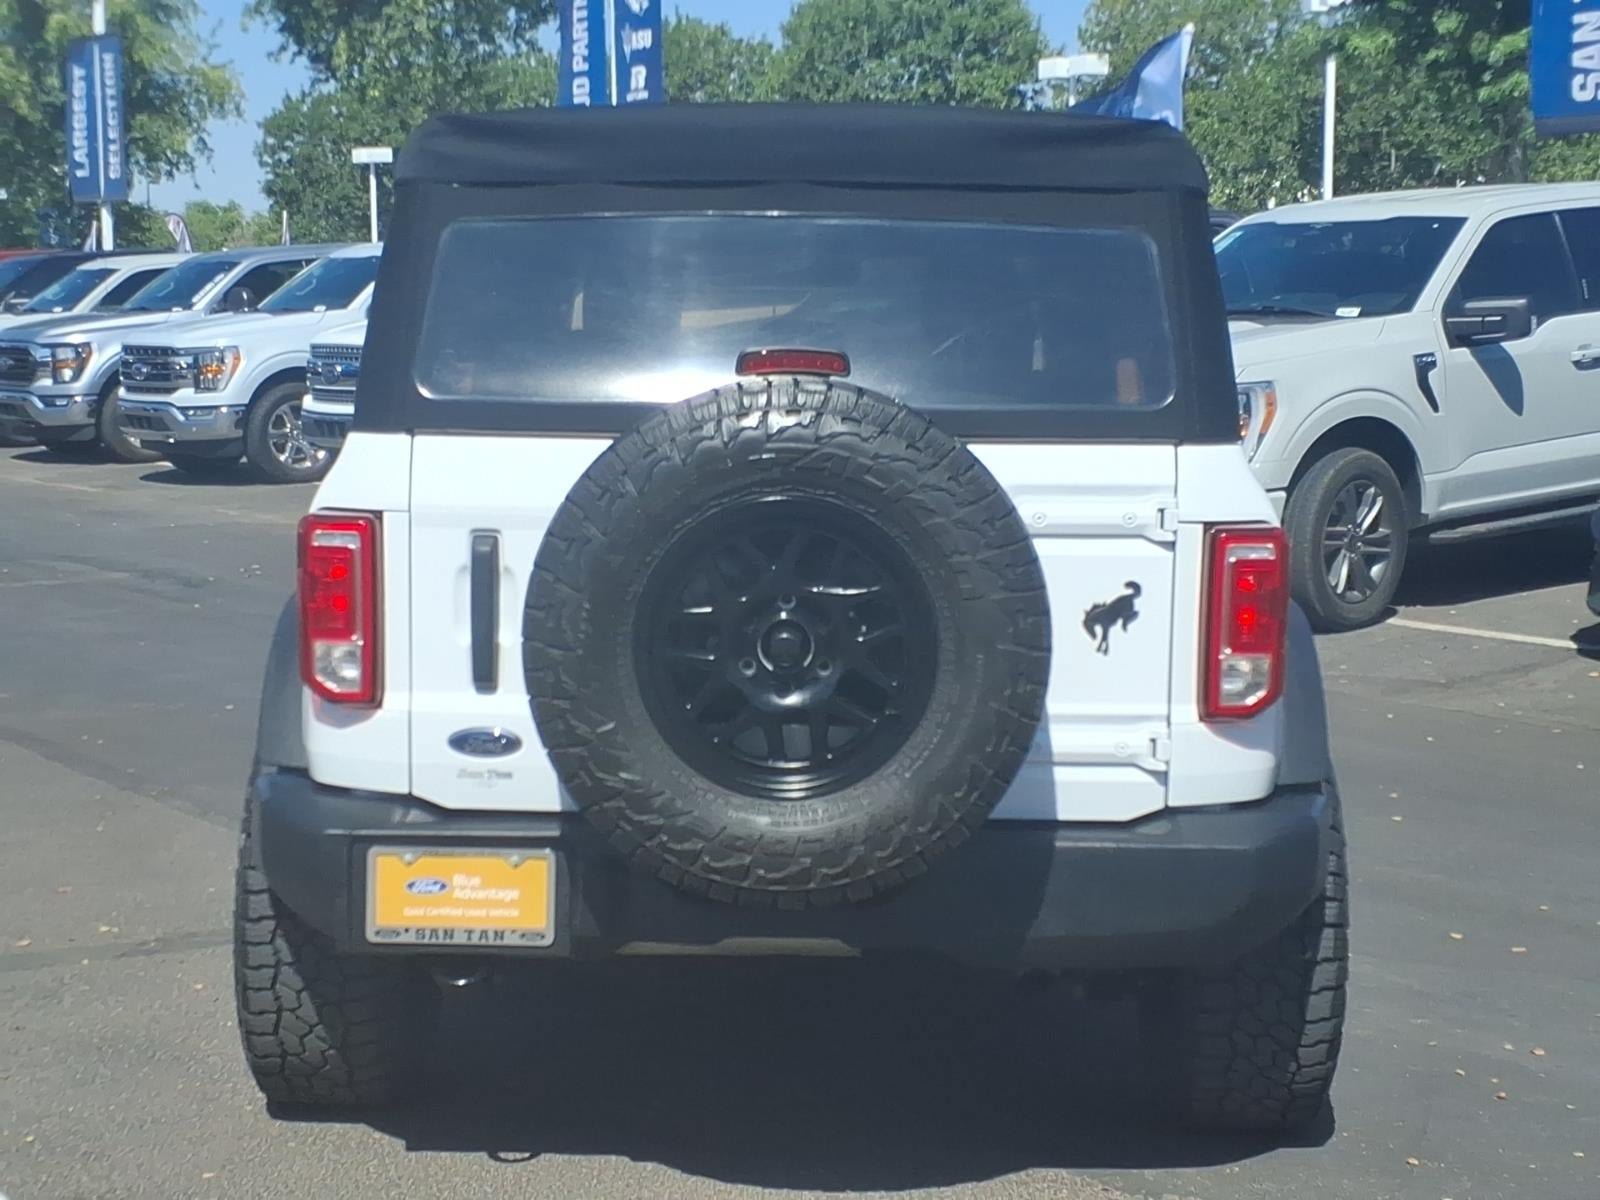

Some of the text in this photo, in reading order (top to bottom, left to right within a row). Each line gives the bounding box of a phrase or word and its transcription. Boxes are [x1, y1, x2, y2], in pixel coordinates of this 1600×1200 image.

[1571, 10, 1600, 102] SAN
[72, 64, 89, 178] LARGEST
[102, 53, 121, 179] SELECTION
[415, 928, 505, 943] SAN TAN
[453, 888, 519, 902] Advantage
